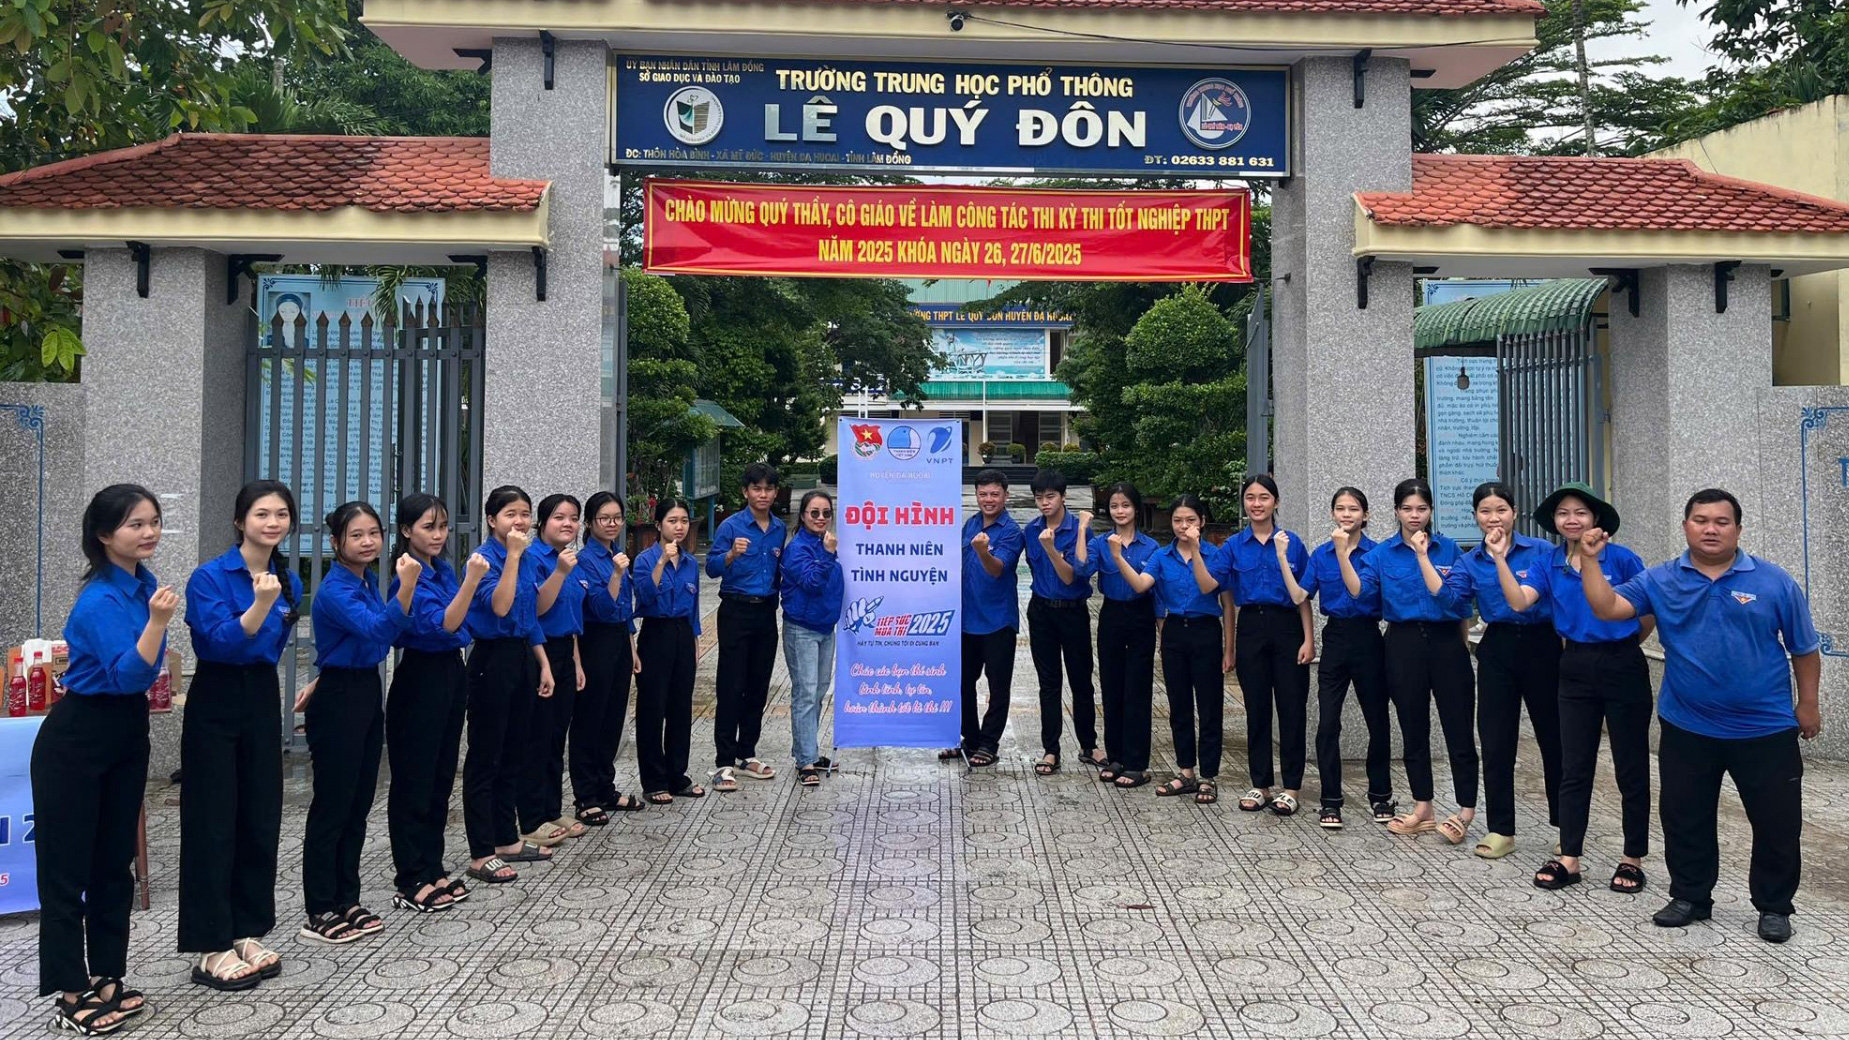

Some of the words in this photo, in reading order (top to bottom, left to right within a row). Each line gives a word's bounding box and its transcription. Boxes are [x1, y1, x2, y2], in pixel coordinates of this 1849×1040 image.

[674, 73, 690, 84] DỤC
[692, 72, 703, 83] VÀ
[725, 74, 740, 85] TẠO
[776, 65, 866, 92] TRƯỜNG
[874, 72, 945, 94] TRUNG
[955, 74, 999, 99] HỌC
[1007, 67, 1053, 96] PHỔ
[1060, 72, 1133, 97] THÔNG
[765, 95, 838, 142] LÊ
[865, 100, 989, 150] QUÝ
[1016, 100, 1146, 147] ĐÔN
[643, 147, 666, 159] THÔN
[1171, 155, 1215, 166] 02633
[1218, 156, 1245, 166] 881
[1248, 157, 1275, 167] 631
[665, 195, 706, 222] CHÀO
[710, 197, 755, 224] MỪNG
[759, 197, 787, 225] QUÝ
[793, 195, 832, 228] THẦY,
[836, 199, 856, 226] CÔ
[860, 199, 895, 227] GIÁO
[899, 196, 917, 227] VỀ
[921, 199, 952, 228] LÀM
[956, 201, 996, 229] CÔNG
[1001, 201, 1028, 229] TÁC
[1032, 207, 1054, 229] THI
[1059, 202, 1077, 229] KỲ
[1081, 207, 1104, 230] THI
[1108, 200, 1133, 230] TỐT
[1138, 203, 1191, 235] NGHIỆP
[1195, 208, 1230, 231] THPT
[818, 235, 853, 262] NĂM
[857, 240, 893, 263] 2025
[897, 236, 937, 263] KHÓA
[941, 237, 980, 264] NGÀY
[984, 245, 1006, 267] 26,
[1010, 242, 1082, 265] 27/6/2025
[933, 311, 953, 321] THPT
[1005, 308, 1031, 323] HUYỆN
[926, 457, 954, 465] VNPT
[845, 501, 889, 530] ĐỘI
[895, 502, 954, 525] HÌNH
[856, 543, 906, 556] THANH
[910, 541, 944, 556] NIÊN
[851, 566, 885, 582] TÌNH
[890, 567, 948, 585] NGUYỆN
[908, 611, 952, 634] 2025
